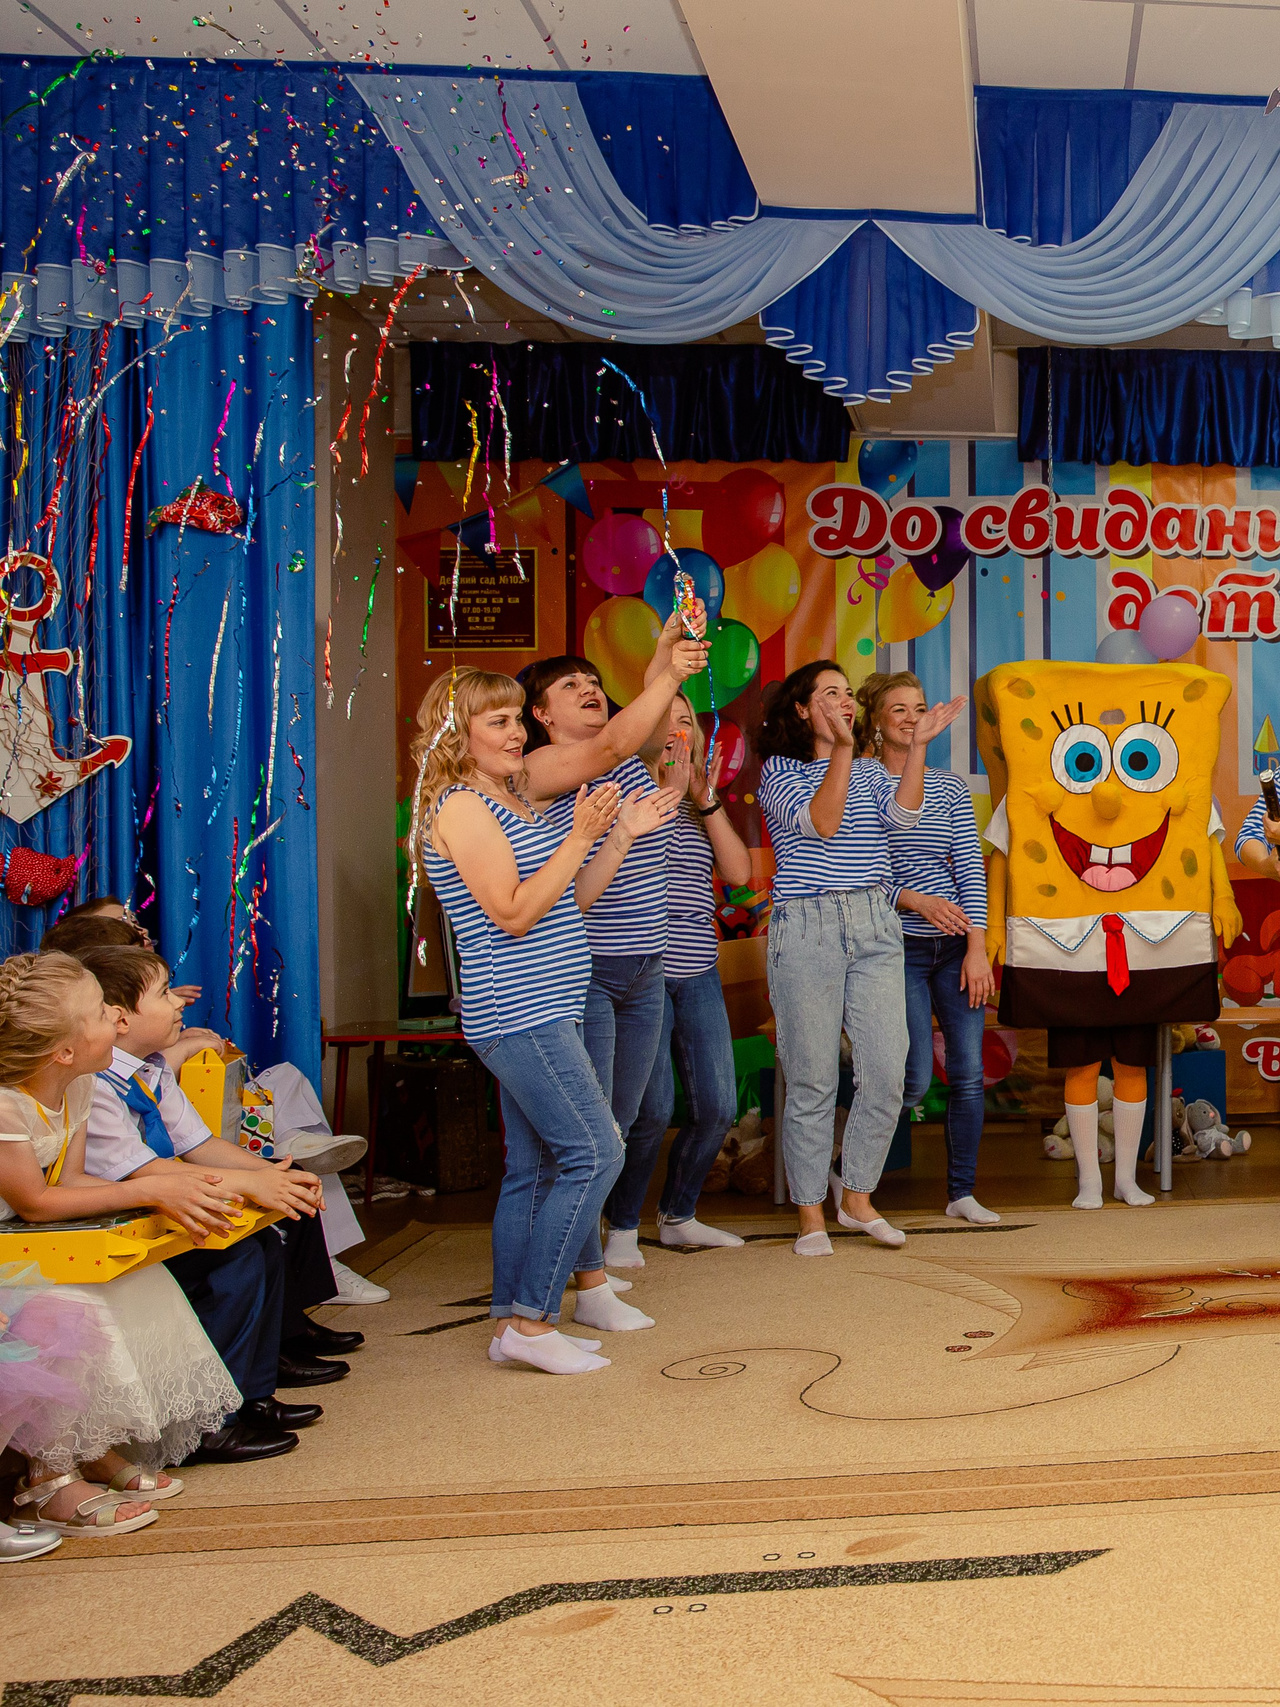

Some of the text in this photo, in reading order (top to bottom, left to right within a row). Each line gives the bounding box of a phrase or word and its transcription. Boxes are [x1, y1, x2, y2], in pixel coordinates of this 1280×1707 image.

[809, 485, 942, 557] До
[480, 577, 496, 586] сад
[462, 606, 501, 614] 07.00-19.00
